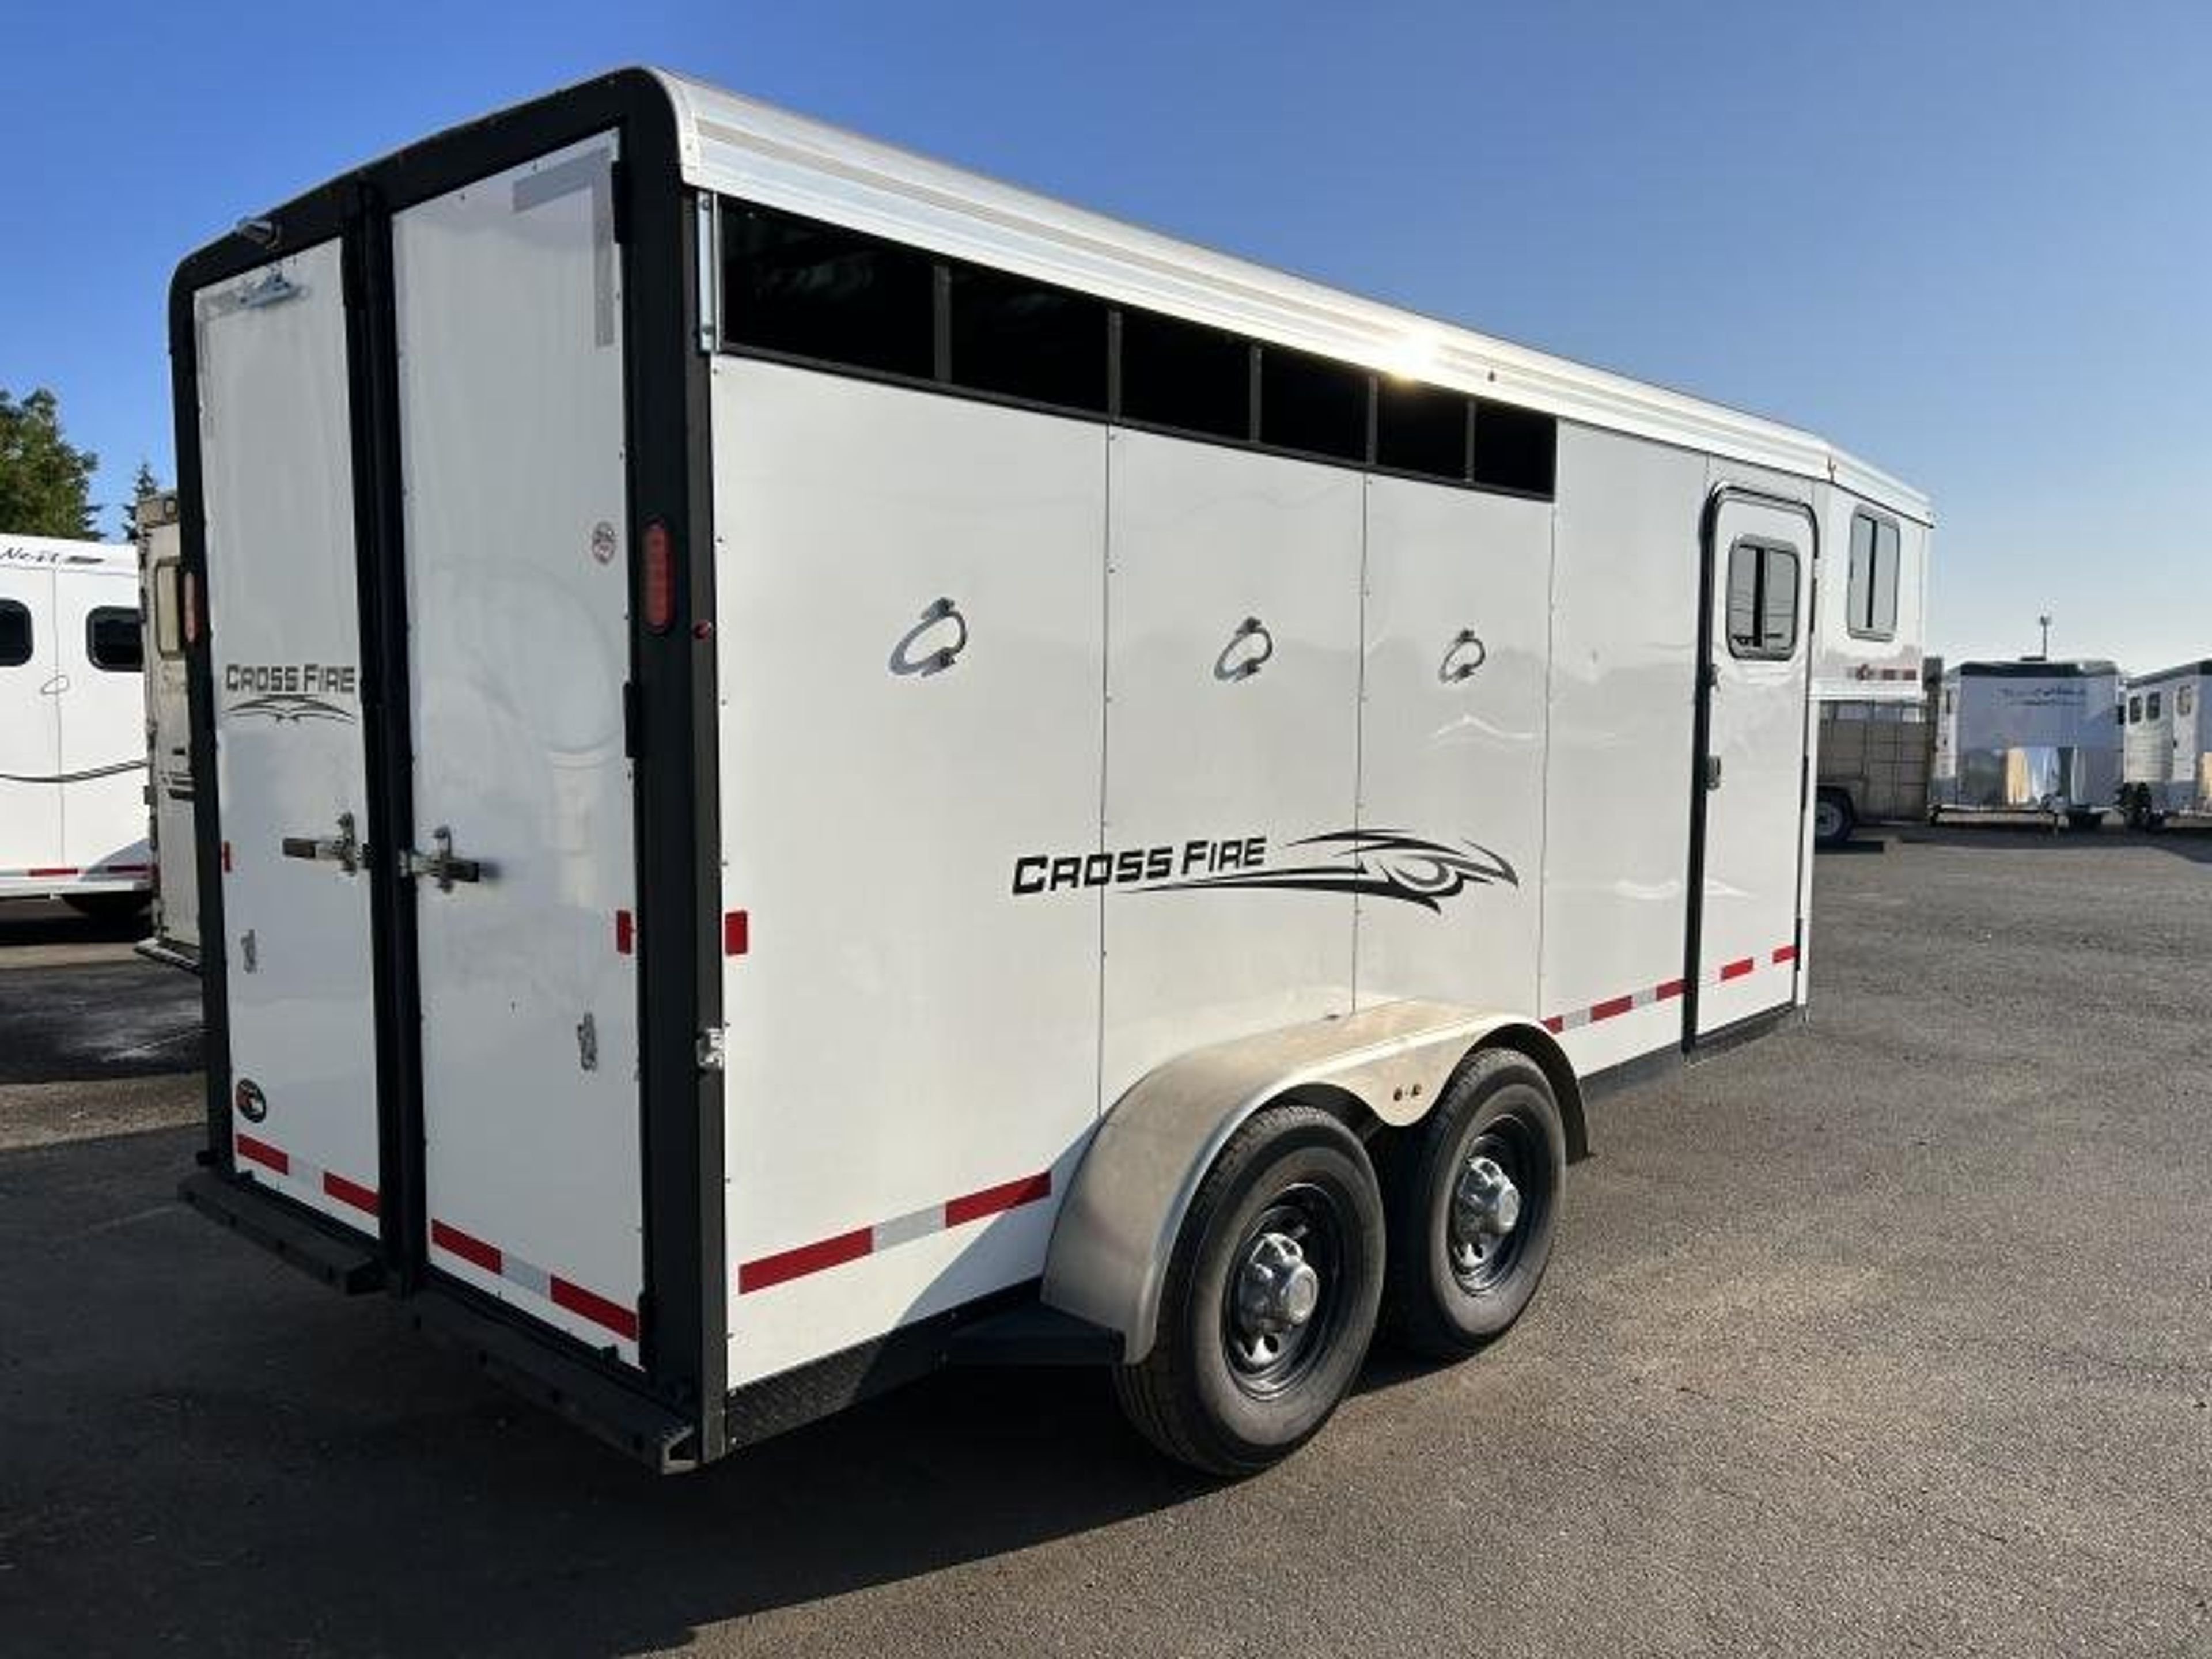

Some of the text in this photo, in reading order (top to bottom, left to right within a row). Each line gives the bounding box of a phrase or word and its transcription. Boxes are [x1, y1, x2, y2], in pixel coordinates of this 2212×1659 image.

[226, 664, 355, 692] CROSS FIRE
[1012, 836, 1267, 895] CROSS FIRE
